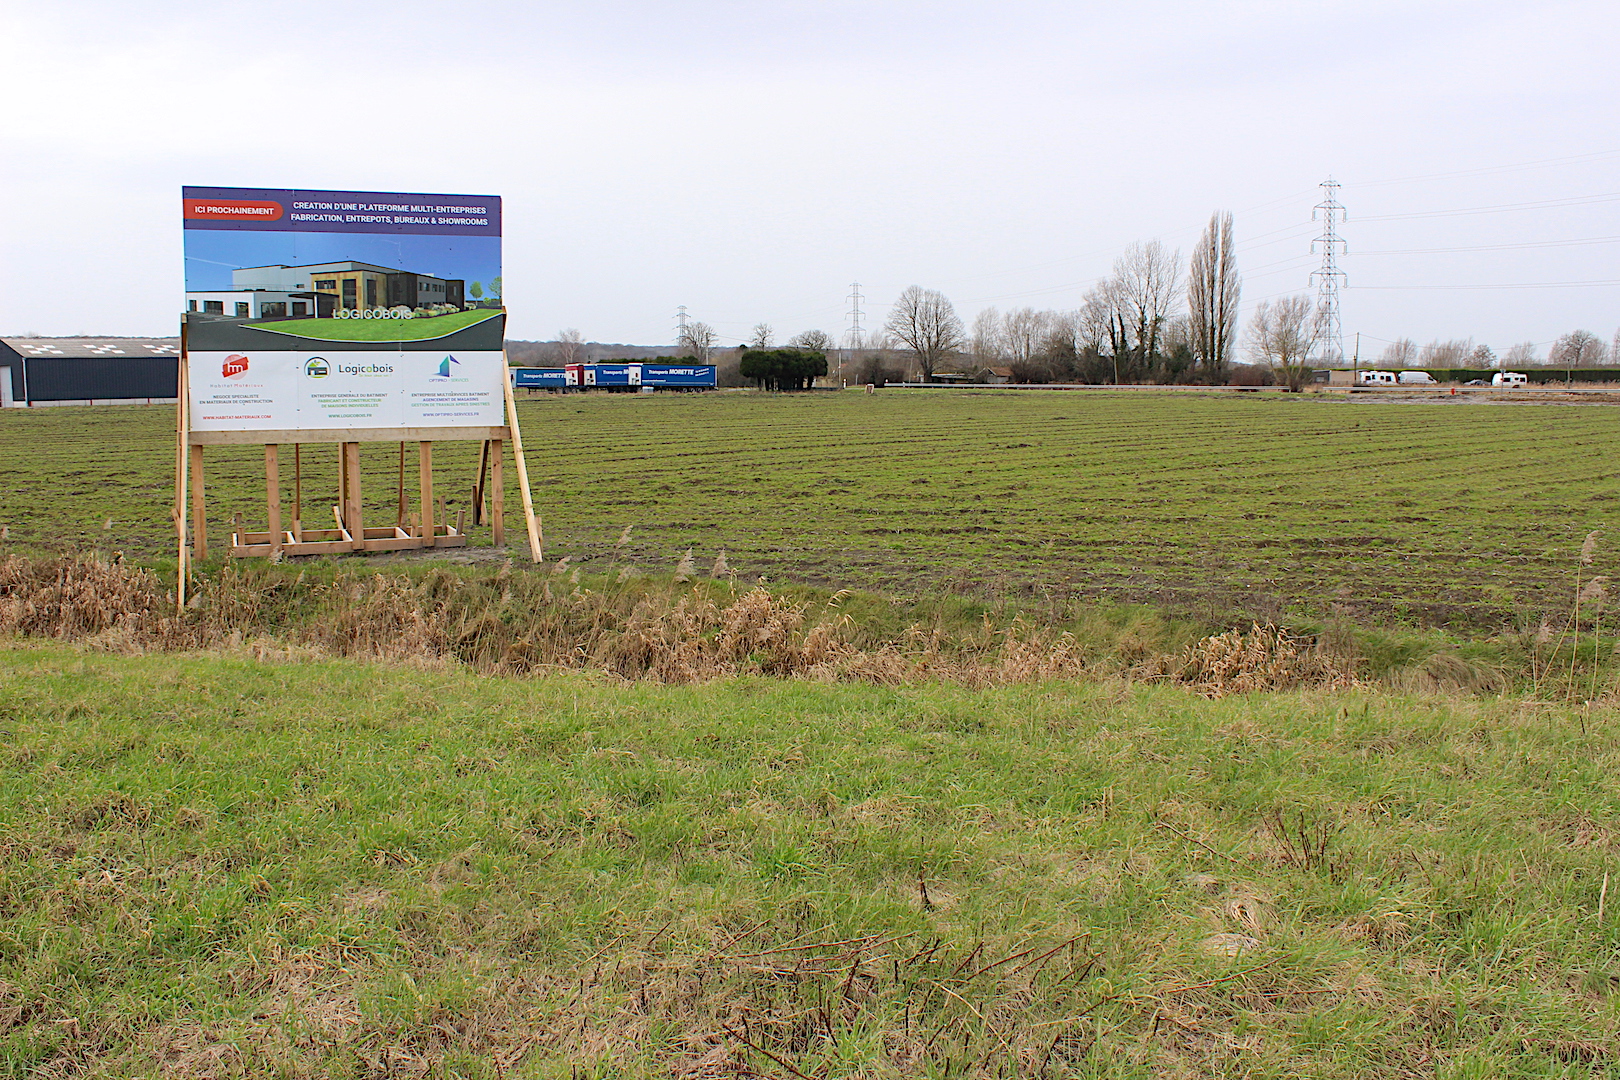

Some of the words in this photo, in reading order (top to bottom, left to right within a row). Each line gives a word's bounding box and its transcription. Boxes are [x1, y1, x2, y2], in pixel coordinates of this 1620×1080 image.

[207, 207, 274, 215] PROCHAINEMENT
[294, 202, 333, 210] CREATION
[359, 204, 409, 212] PLATEFORME
[411, 205, 486, 214] MULTI-ENTREPRISES
[291, 214, 344, 223] FABRICATION,
[346, 215, 393, 224] ENTREPOTS,
[438, 217, 488, 226] SHOWROOMS
[333, 309, 412, 320] LOGICOBOIS
[339, 364, 393, 375] Logicobois
